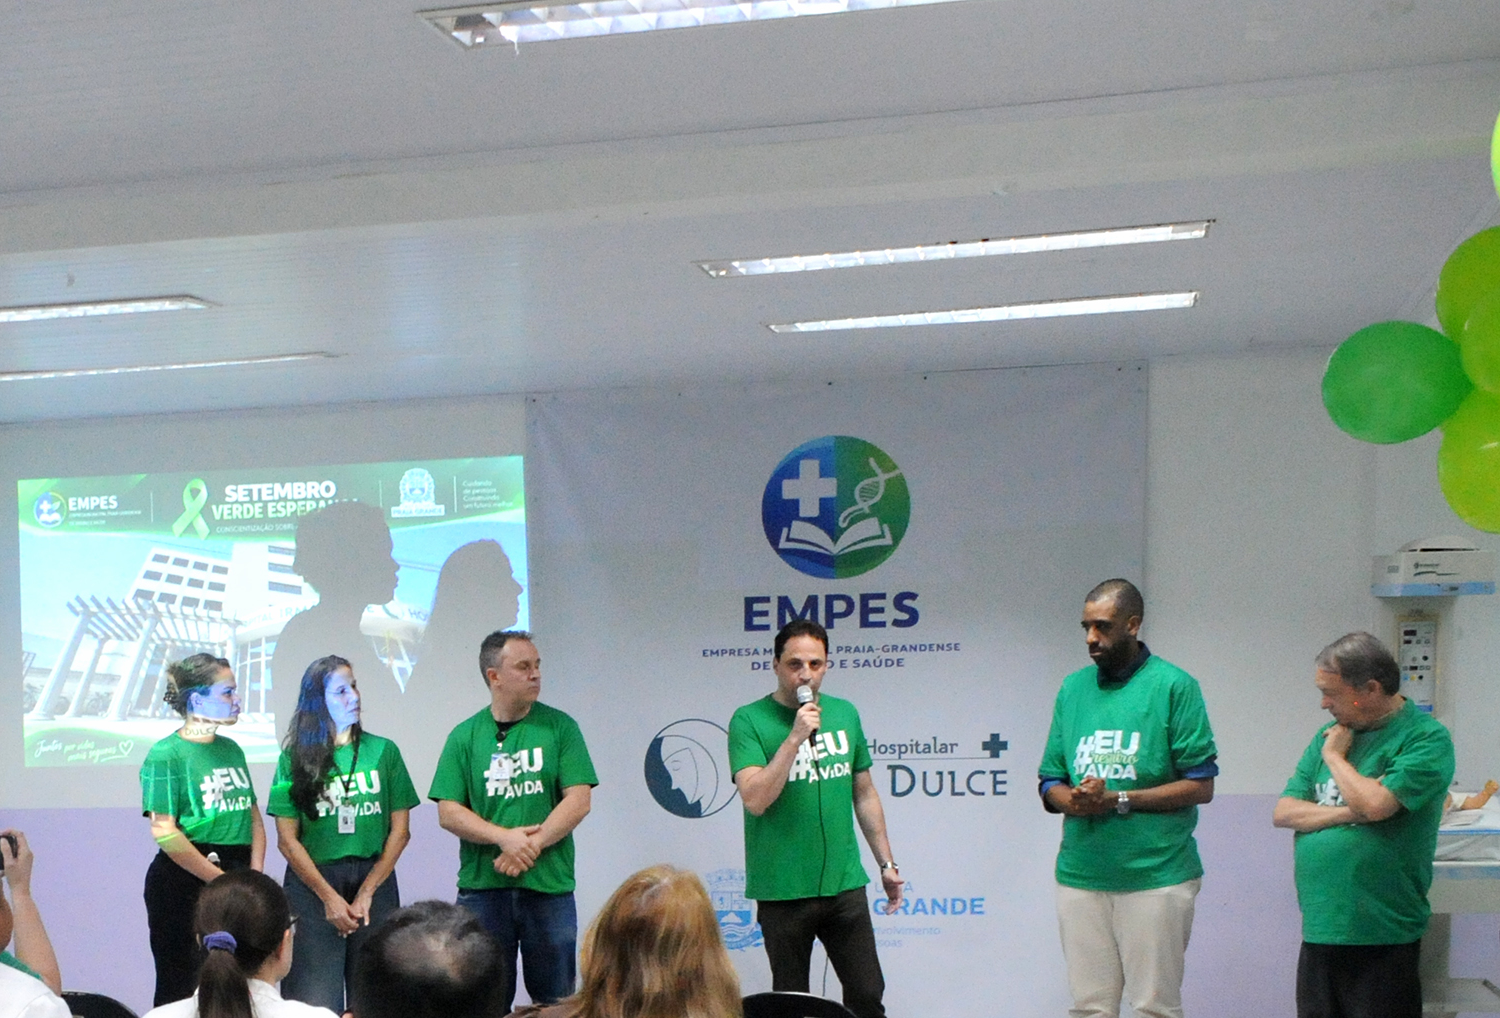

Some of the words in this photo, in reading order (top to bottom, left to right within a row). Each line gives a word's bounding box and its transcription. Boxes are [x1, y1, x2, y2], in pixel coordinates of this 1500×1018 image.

[225, 480, 337, 502] SETEMBRO
[68, 495, 118, 511] EMPES
[211, 503, 264, 520] VERDE
[267, 498, 358, 519] ESPERA
[743, 591, 920, 632] EMPES
[702, 647, 760, 659] EMPRESA
[836, 643, 961, 655] PRAIA-GRANDENSE
[751, 661, 771, 671] DE
[840, 659, 848, 669] E
[852, 656, 905, 669] SAÚDE
[867, 737, 959, 760] Hospitalar
[1073, 730, 1141, 776] #EU
[200, 767, 251, 810] #EU
[887, 764, 1008, 798] DULCE
[873, 897, 986, 916] GRANDE
